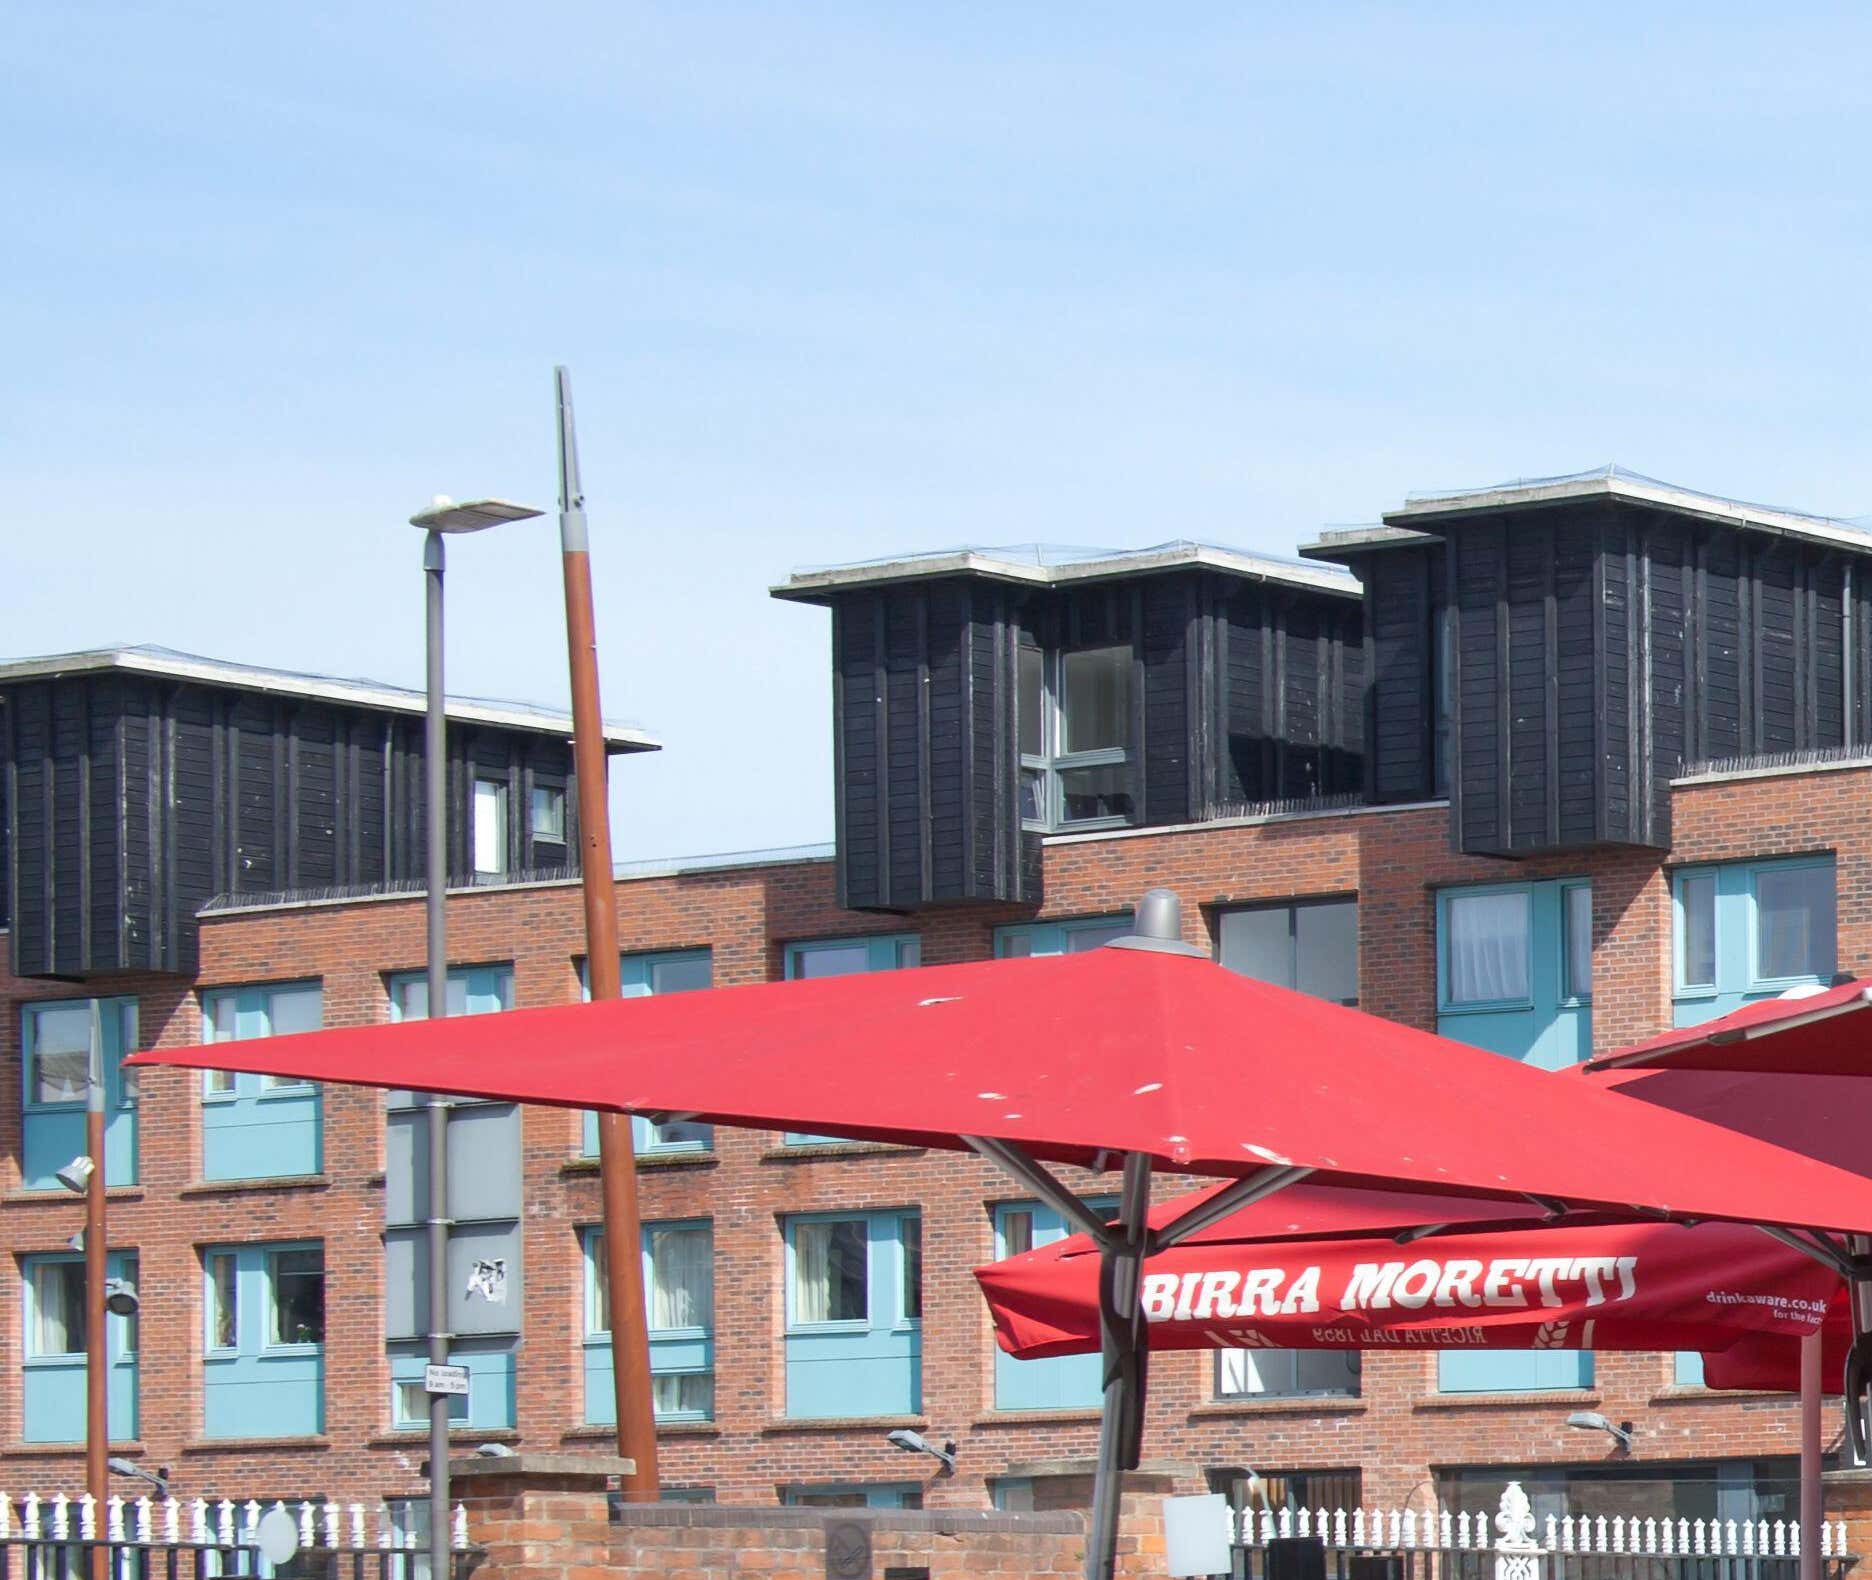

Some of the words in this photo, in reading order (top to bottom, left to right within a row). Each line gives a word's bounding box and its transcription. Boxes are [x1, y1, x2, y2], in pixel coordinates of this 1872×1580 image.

[1141, 1265, 1320, 1325] BIRRA
[1341, 1256, 1638, 1311] MORETTI
[1706, 1291, 1827, 1313] drinkaware.co.uk
[1774, 1309, 1789, 1320] for
[1791, 1311, 1806, 1322] the
